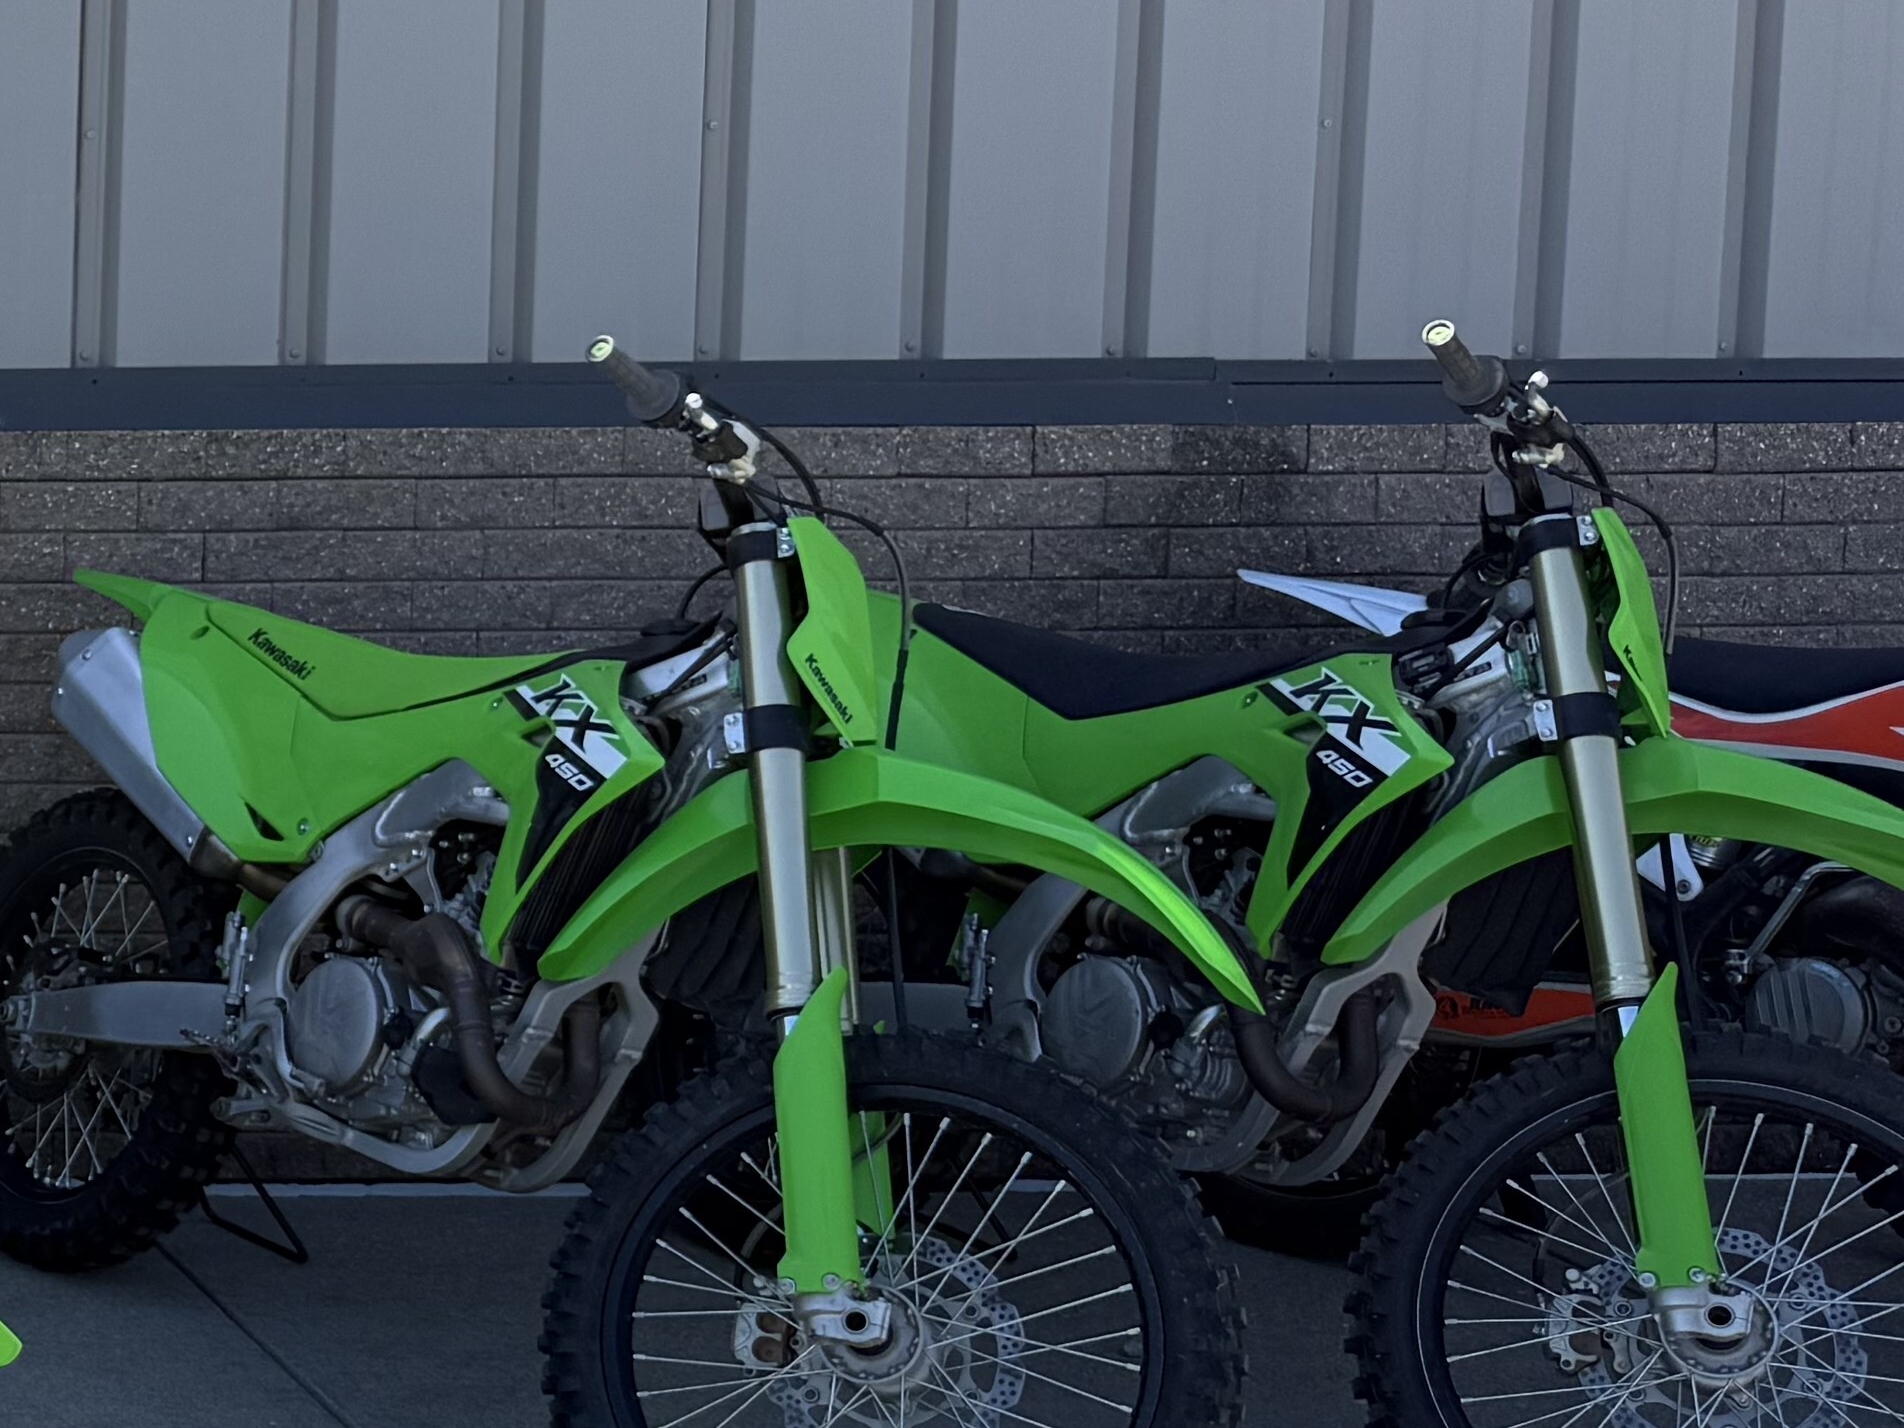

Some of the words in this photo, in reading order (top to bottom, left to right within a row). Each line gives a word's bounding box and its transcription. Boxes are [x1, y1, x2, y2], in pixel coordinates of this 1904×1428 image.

[247, 627, 316, 681] Kawasaki
[530, 672, 620, 755] KX
[805, 653, 853, 725] Kawasaki
[1288, 666, 1402, 752] KX
[545, 754, 594, 791] 450
[1315, 750, 1373, 788] 450
